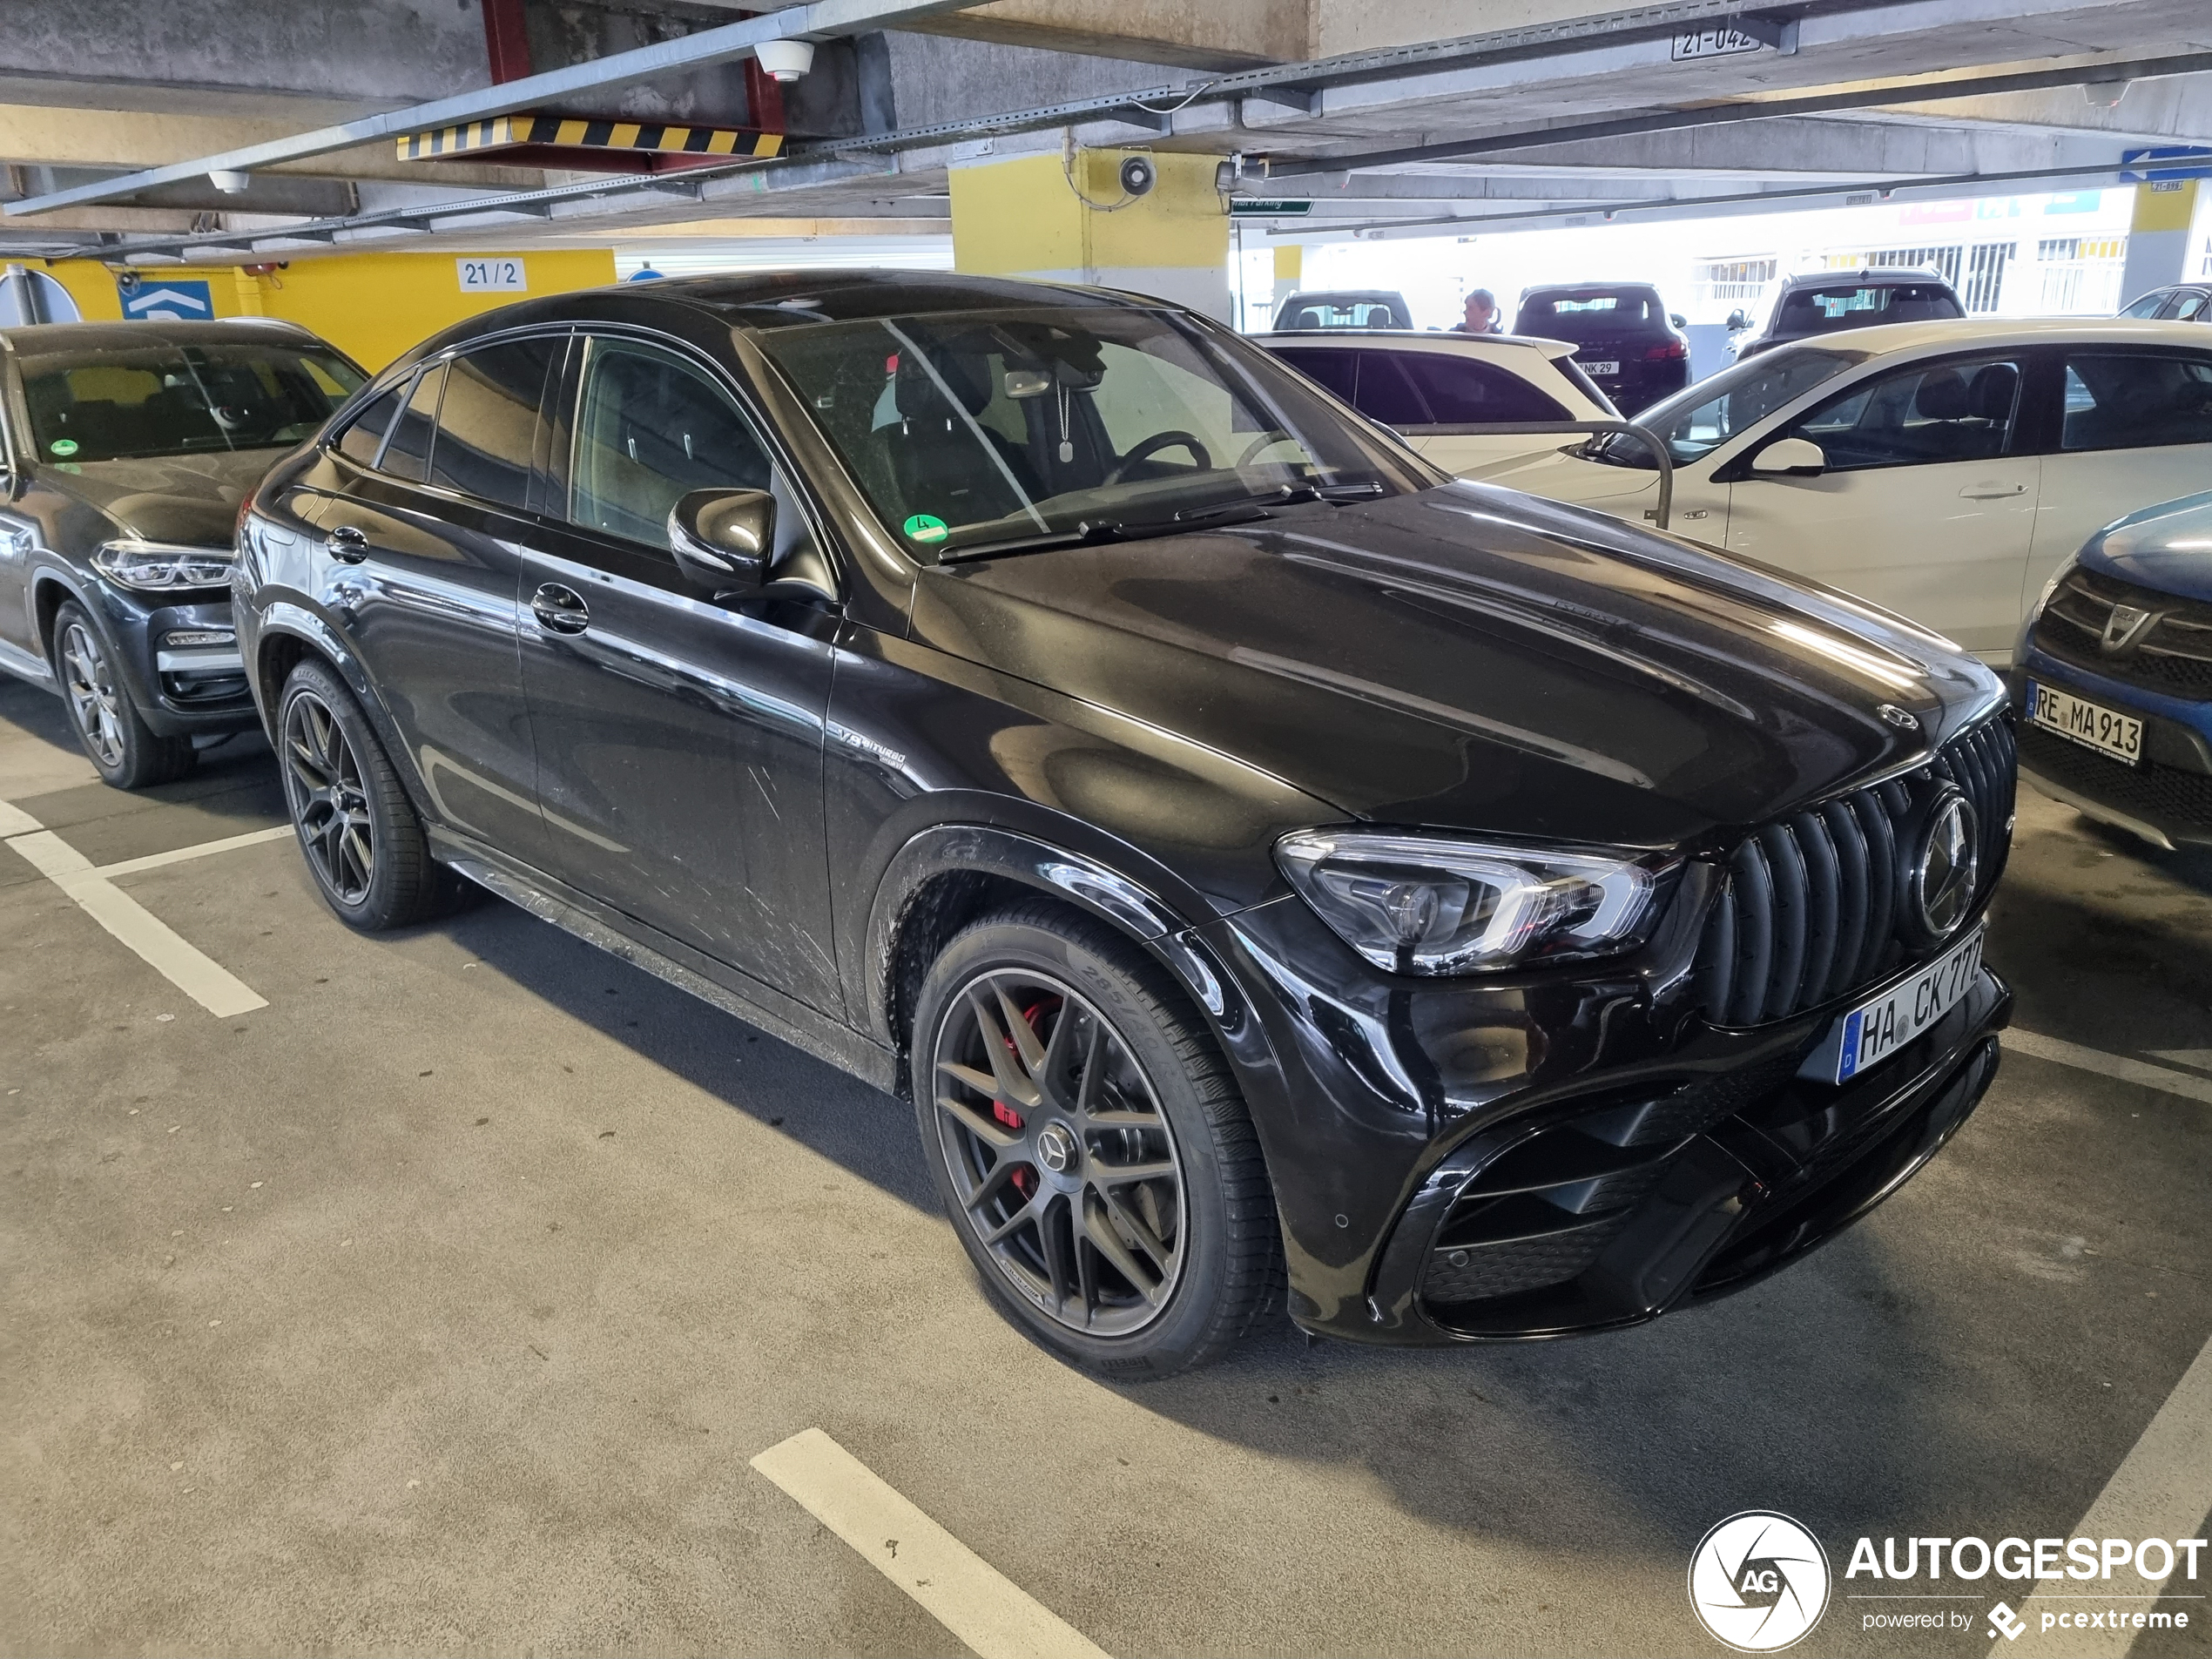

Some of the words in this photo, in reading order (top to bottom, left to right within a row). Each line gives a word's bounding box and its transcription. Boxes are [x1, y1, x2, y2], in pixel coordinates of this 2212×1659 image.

[1600, 363, 1612, 373] 29
[916, 516, 929, 529] 4
[2036, 688, 2060, 724] RE
[2070, 701, 2094, 738] MA
[2100, 712, 2139, 753] 913
[861, 738, 906, 764] BITURBO
[1844, 1054, 1852, 1069] D
[1859, 997, 1895, 1063] HA
[1913, 964, 1946, 1027] CK
[1949, 933, 1982, 1002] 777
